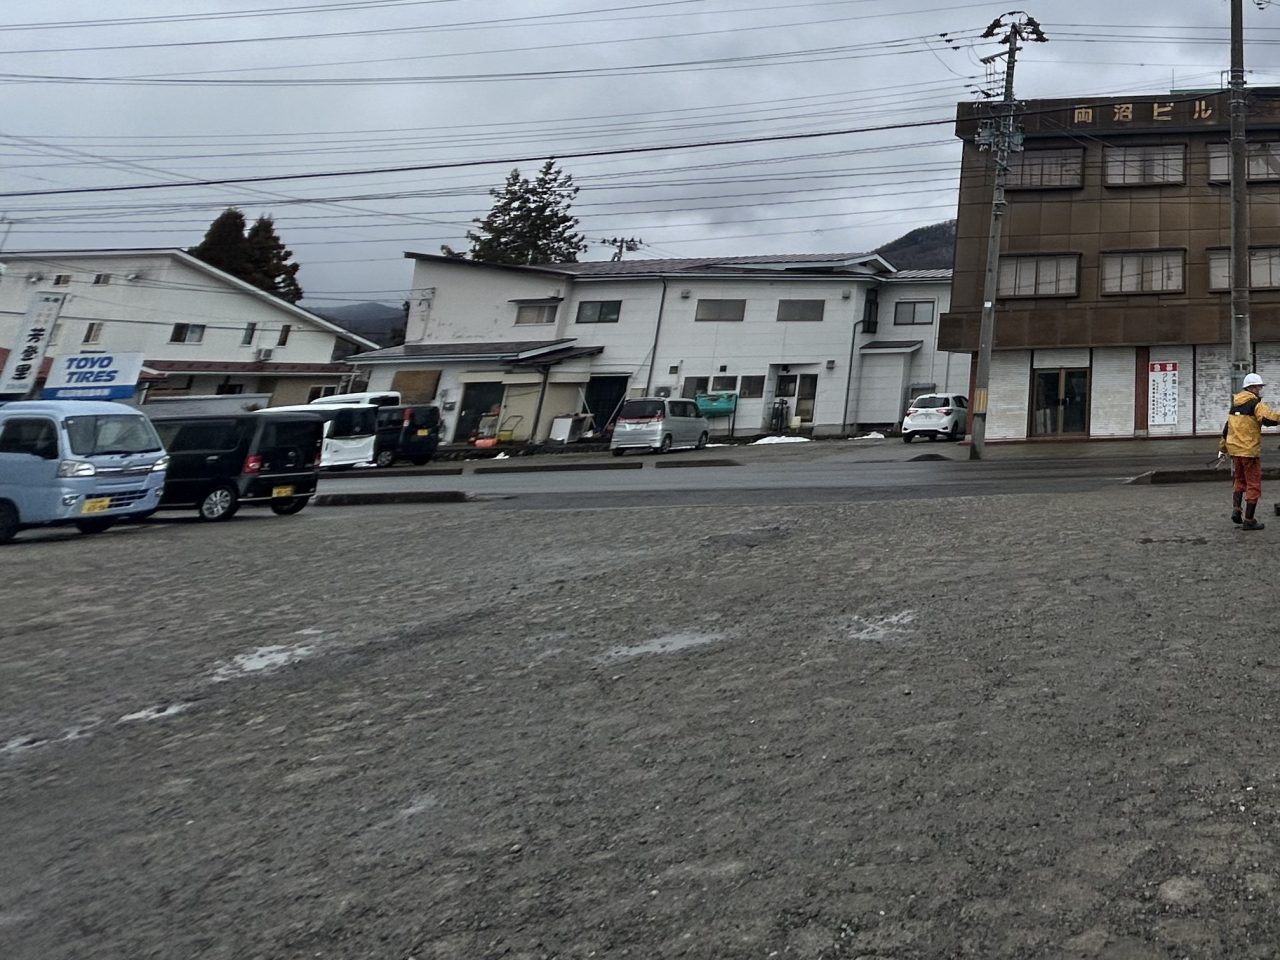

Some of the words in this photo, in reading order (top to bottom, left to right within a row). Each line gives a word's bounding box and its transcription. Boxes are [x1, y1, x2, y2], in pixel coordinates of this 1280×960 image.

[1074, 100, 1213, 124] 両沼ビル
[66, 356, 114, 370] TOYO
[65, 370, 119, 383] TIRES
